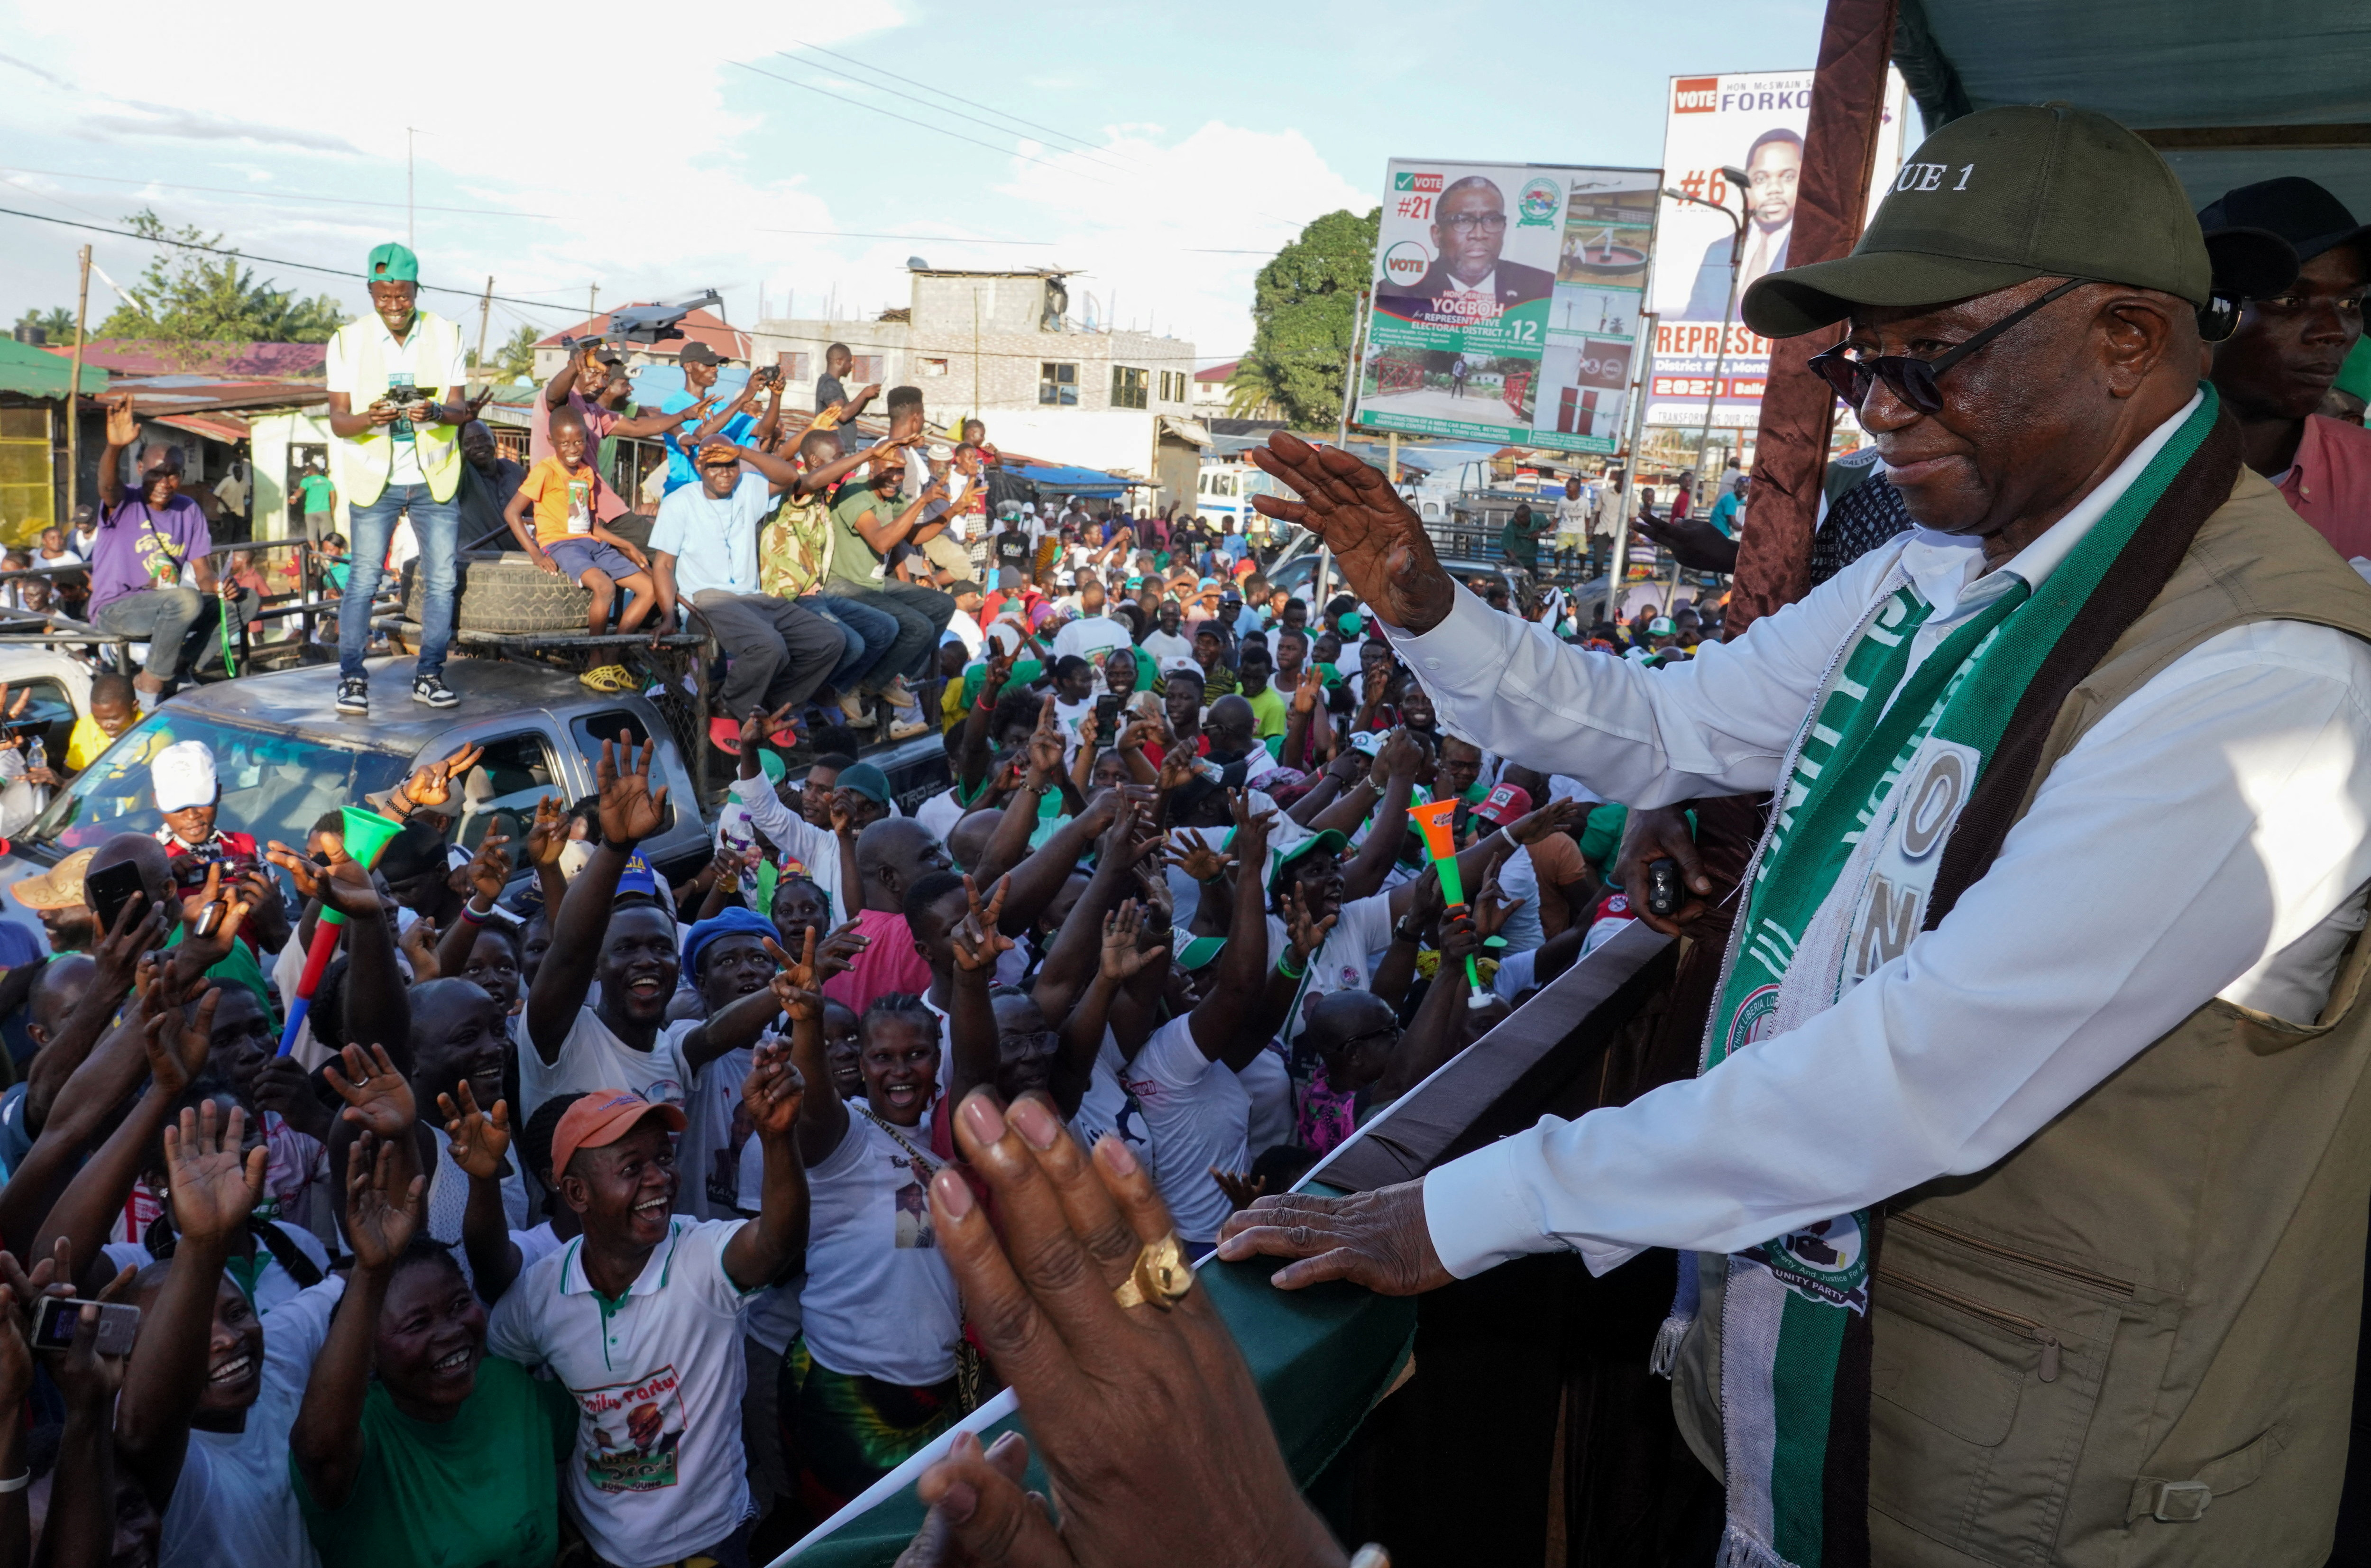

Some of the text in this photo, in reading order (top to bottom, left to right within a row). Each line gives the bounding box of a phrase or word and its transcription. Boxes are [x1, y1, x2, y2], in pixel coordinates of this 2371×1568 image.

[1677, 90, 1717, 109] VOTE
[1415, 177, 1443, 189] VOTE
[1677, 168, 1727, 206] #6
[1886, 163, 1974, 196] UE 1
[1397, 196, 1432, 220] #21
[1388, 258, 1424, 273] VOTE
[1431, 298, 1505, 318] YOGBOH
[1411, 321, 1461, 333] ELECTORAL
[1462, 326, 1503, 337] DISTRICT
[1424, 312, 1500, 327] REPRESENTATIVE
[1655, 359, 1702, 372] District
[1375, 419, 1405, 428] MARYLAND
[1406, 422, 1427, 430] CENTER
[1433, 425, 1451, 433] BASSA
[1452, 428, 1470, 436] TOWN
[1470, 431, 1511, 441] COMMUNITIES
[1377, 413, 1420, 423] CONSTRUCTION
[1482, 426, 1509, 435] BETWEEN
[1724, 414, 1740, 425] OUR
[1733, 1022, 1745, 1048] THINK
[1742, 999, 1765, 1025] LIBERIA,
[1773, 1244, 1867, 1283] Liberty And Justice For All
[1775, 1269, 1845, 1302] UNITY PARTY
